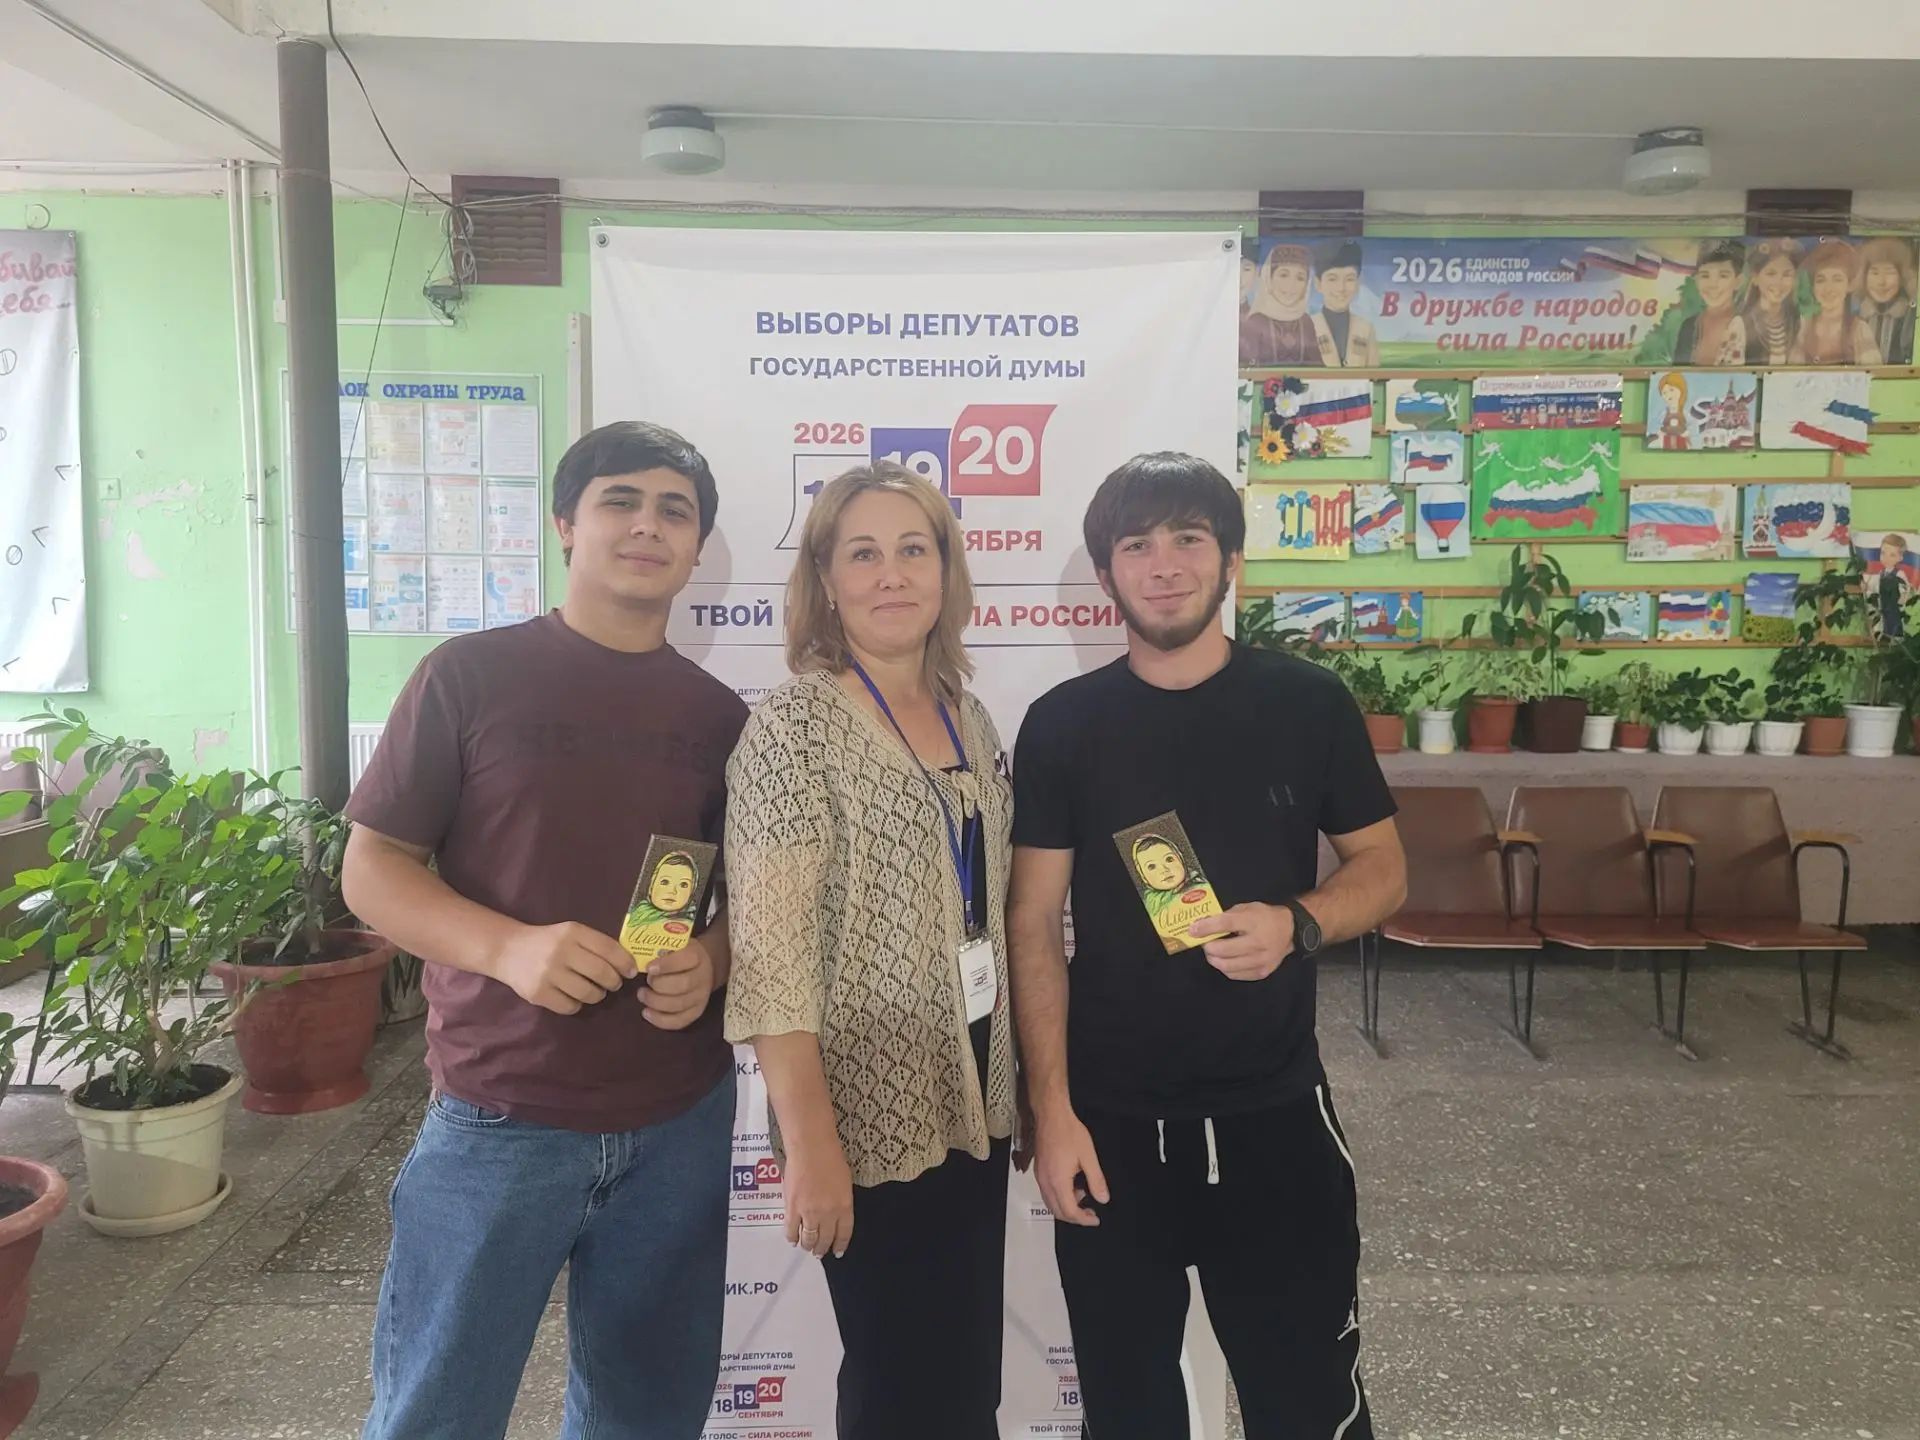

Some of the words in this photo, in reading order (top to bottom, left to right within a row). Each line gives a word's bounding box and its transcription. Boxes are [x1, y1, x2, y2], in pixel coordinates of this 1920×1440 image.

[1391, 256, 1463, 284] 2026
[1466, 258, 1530, 270] ЕДИНСТВО
[1465, 270, 1523, 284] НАРОДОВ
[1526, 271, 1575, 283] РОССИИ
[1380, 291, 1400, 317] В
[1409, 290, 1524, 326] дружбе
[1533, 290, 1659, 326] народов
[756, 311, 891, 335] ВЫБОРЫ
[900, 313, 1079, 339] ДЕПУТАТОВ
[1436, 331, 1508, 351] сила
[1517, 324, 1637, 351] России!
[750, 355, 1002, 379] ГОСУДАРСТВЕННОЙ
[1008, 359, 1086, 381] ДУМЫ
[793, 422, 865, 445] 2026
[958, 425, 1035, 476] 20
[963, 530, 1042, 551] ЯБРЯ
[690, 599, 773, 627] ТВОЙ
[757, 1165, 779, 1178] 20
[735, 1172, 754, 1186] 19
[737, 1192, 782, 1200] СЕНТЯБРЯ
[741, 1352, 793, 1361] ДЕПУТАТОВ
[773, 1363, 796, 1371] ДУМЫ
[758, 1382, 781, 1397] 20
[736, 1390, 755, 1405] 19
[1061, 1391, 1079, 1405] 18
[714, 1399, 733, 1413] 18
[738, 1410, 784, 1419] СЕНТЯБРЯ
[1029, 1424, 1053, 1433] ТВОЙ
